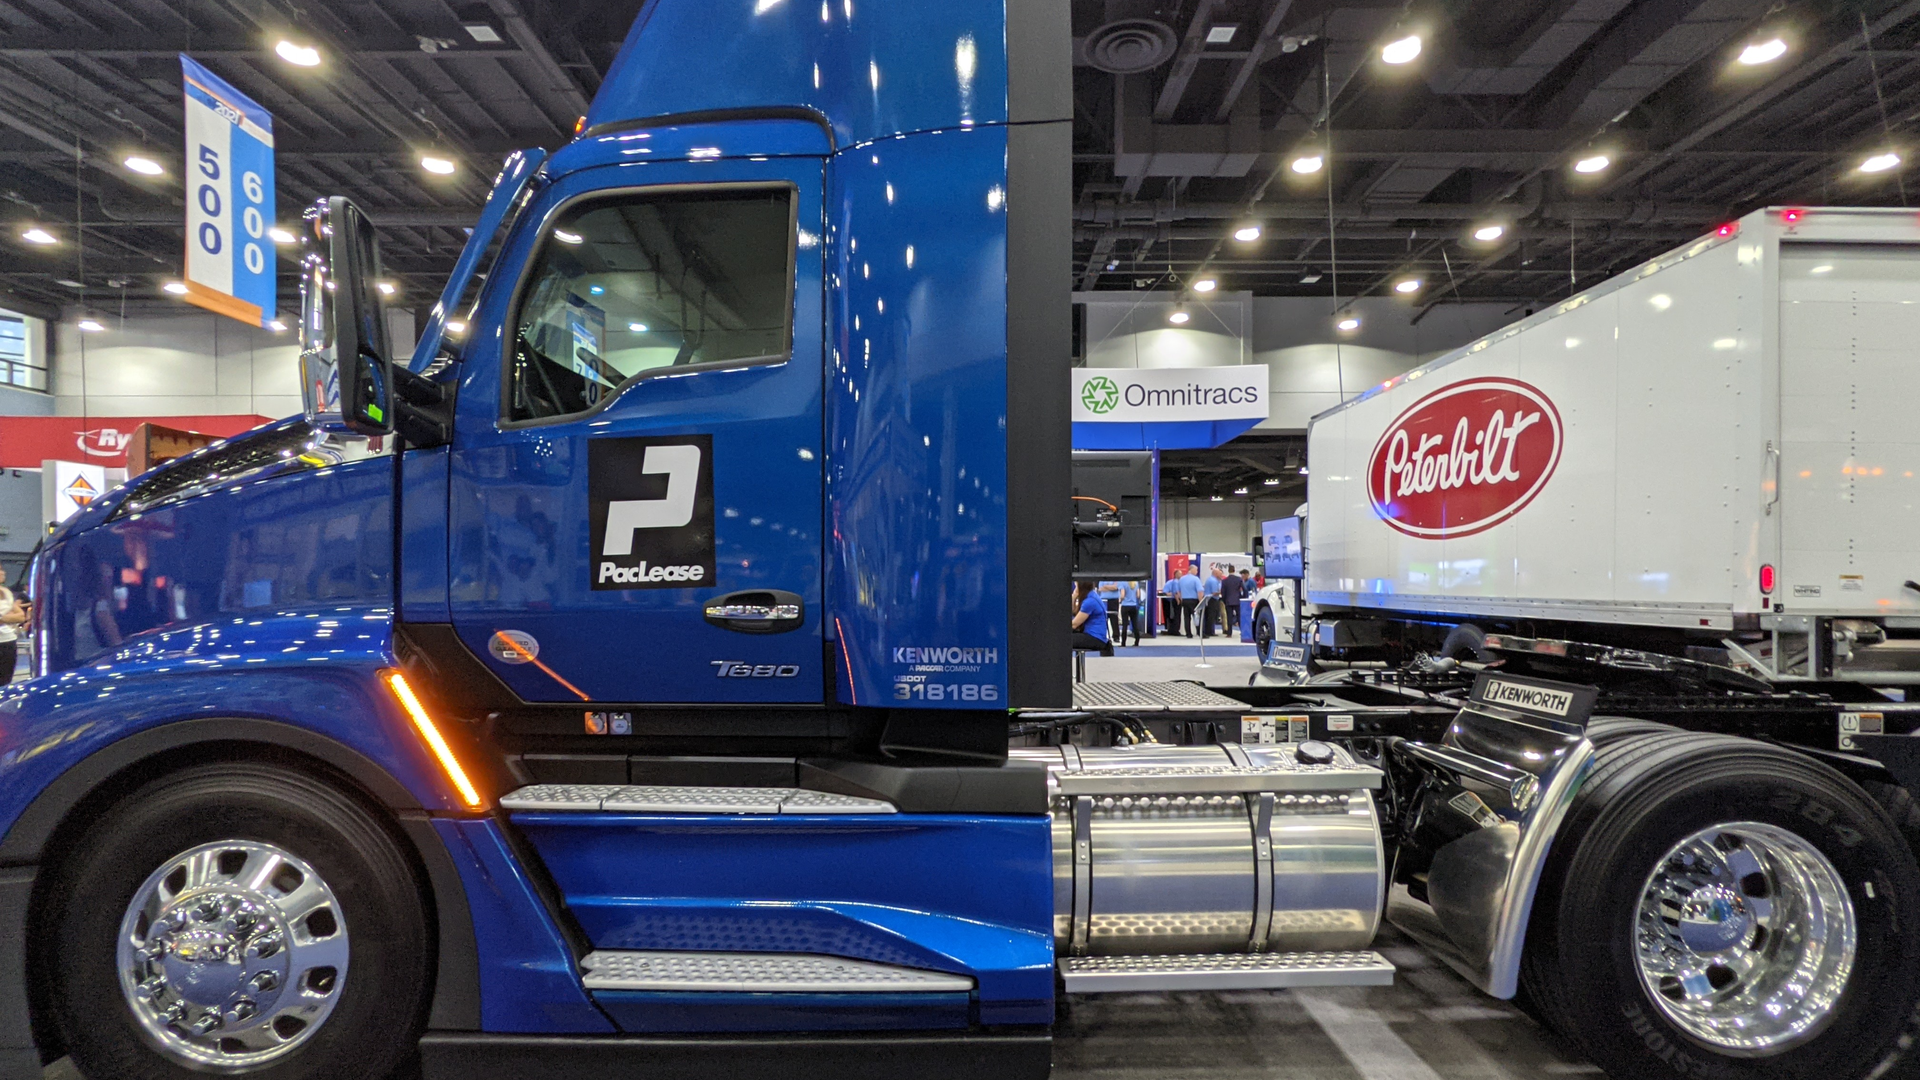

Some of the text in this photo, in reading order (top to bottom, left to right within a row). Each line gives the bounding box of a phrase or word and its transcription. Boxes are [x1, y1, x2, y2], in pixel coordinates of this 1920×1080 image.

[213, 101, 241, 126] 2021
[198, 143, 222, 256] 500
[242, 171, 264, 275] 600
[1124, 383, 1259, 407] Omnitracs
[1383, 409, 1542, 506] Peterbilt
[598, 560, 705, 584] PacLease
[892, 646, 998, 664] KENWORTH
[710, 660, 800, 678] T680
[915, 664, 944, 672] PACCAR
[944, 665, 981, 673] COMPANY
[893, 683, 999, 701] 318186
[1498, 685, 1568, 711] KENWORTH
